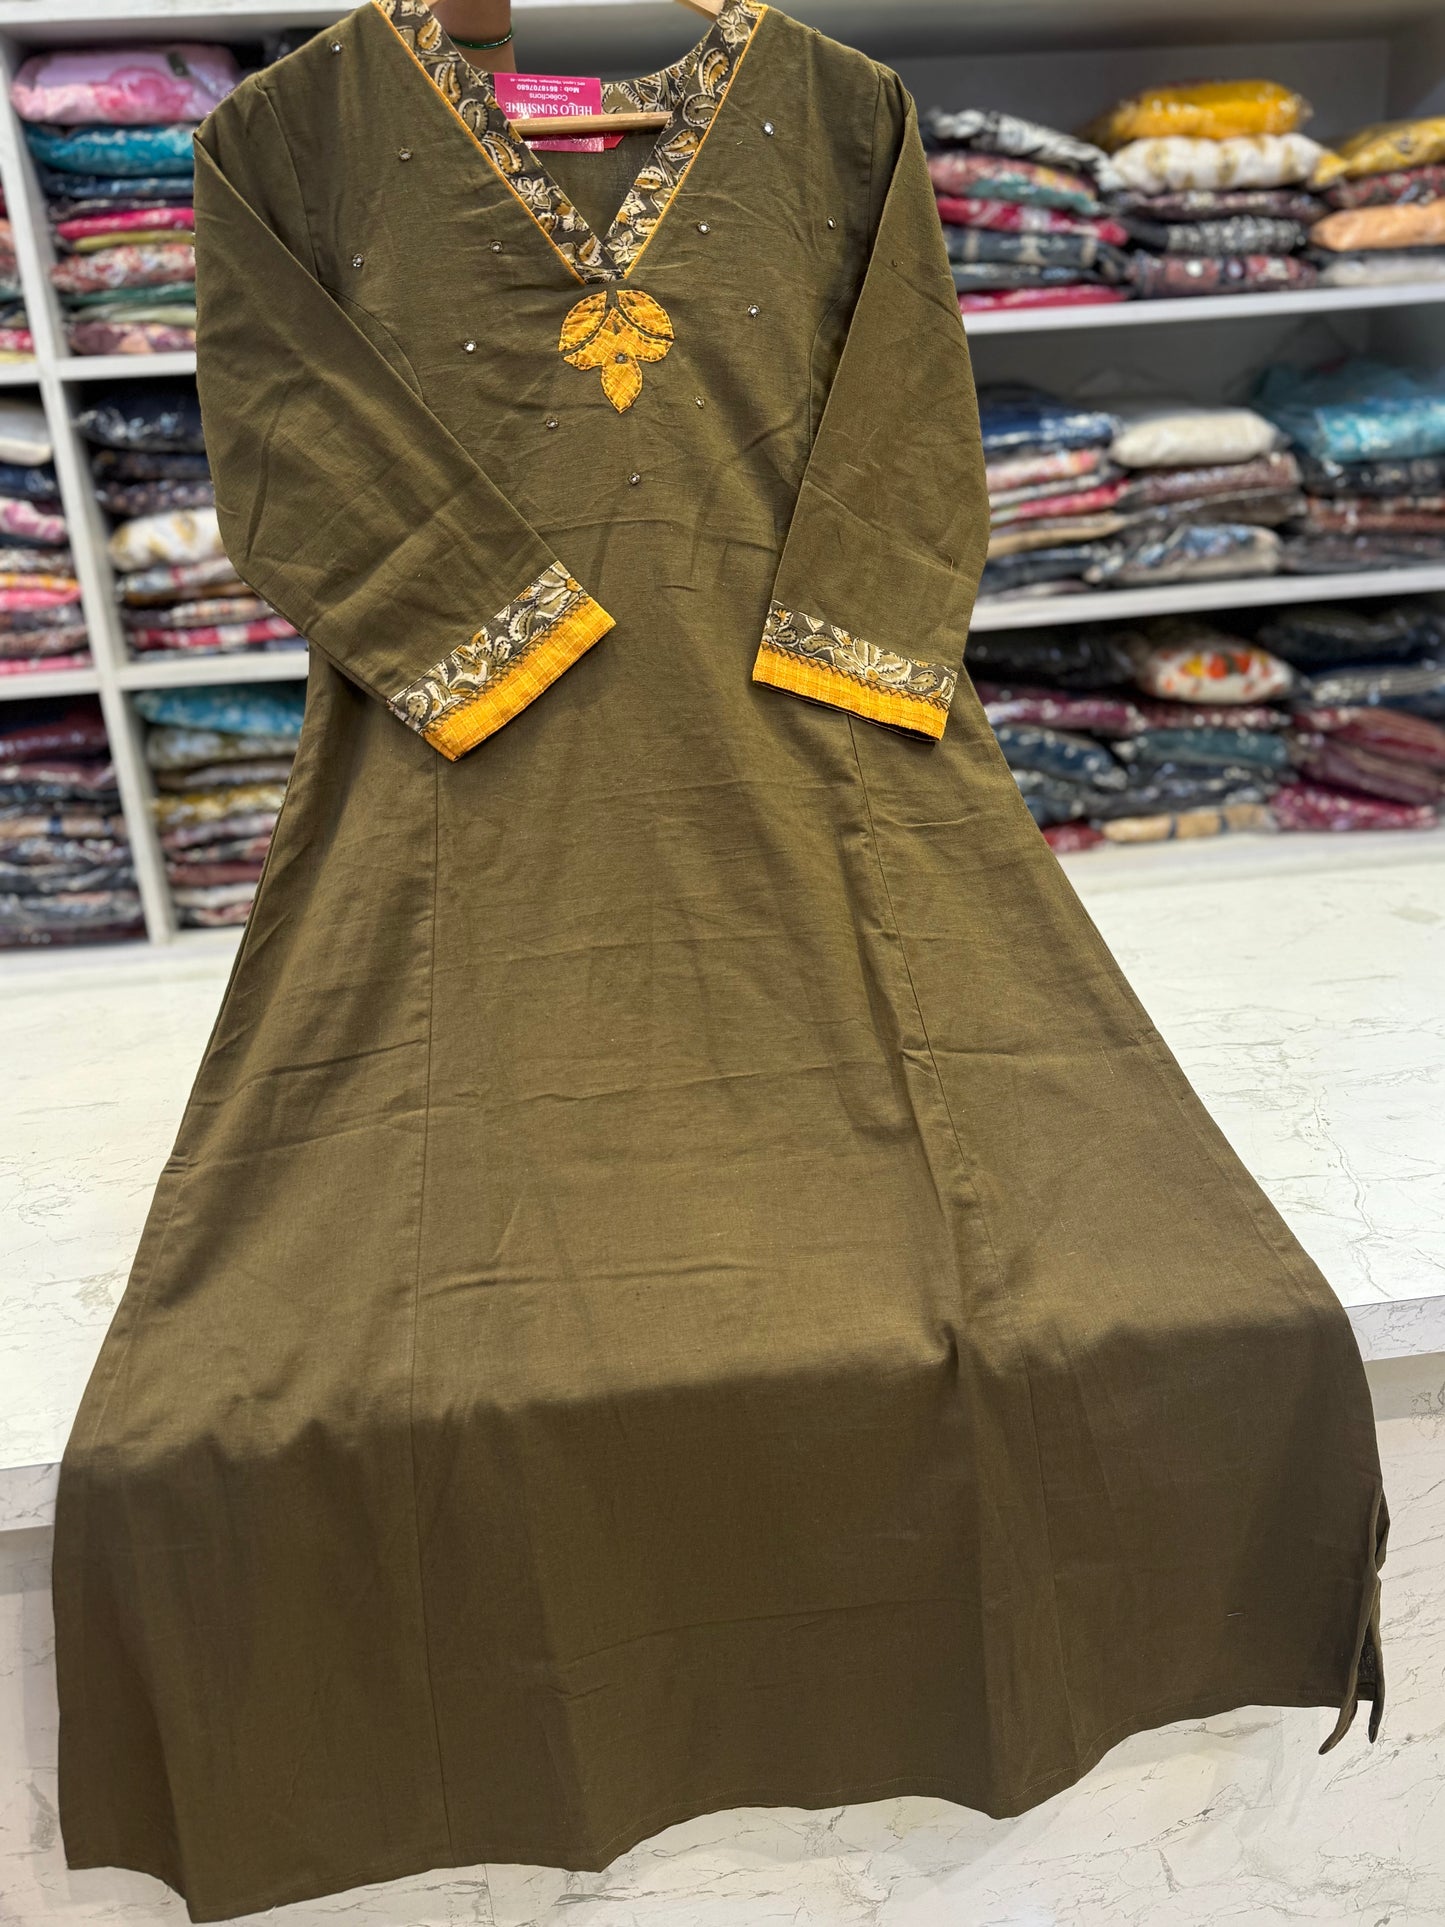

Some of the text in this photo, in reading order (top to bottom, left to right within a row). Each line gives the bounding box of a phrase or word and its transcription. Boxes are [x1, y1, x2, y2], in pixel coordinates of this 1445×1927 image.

[529, 93, 568, 101] Collections
[505, 102, 592, 116] HELLO SUNSHINE
